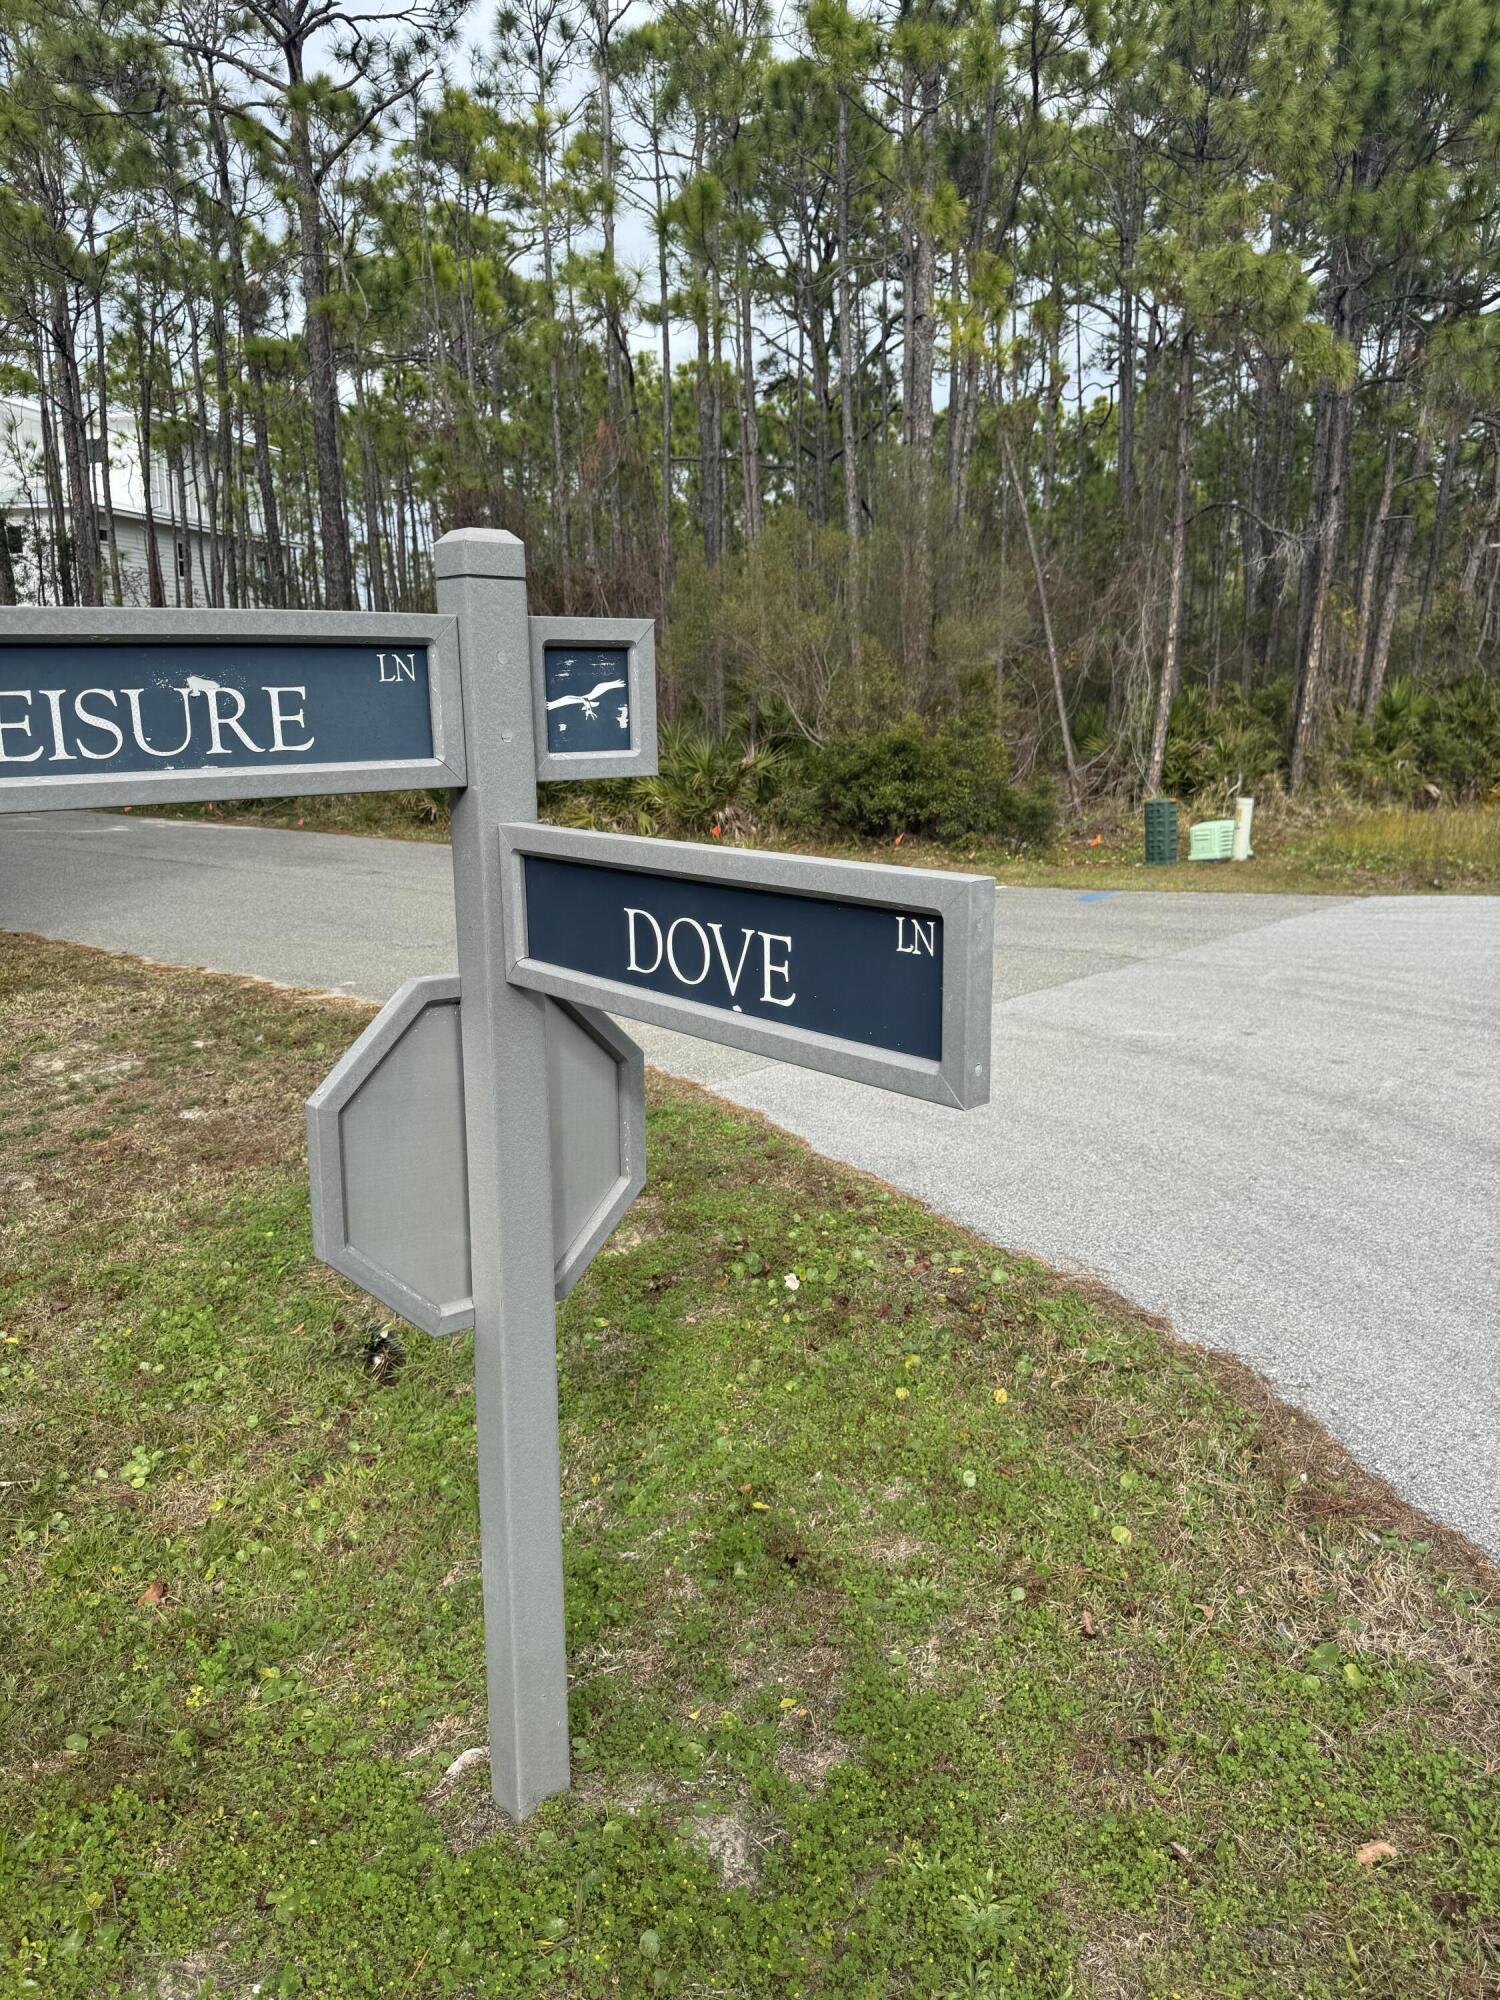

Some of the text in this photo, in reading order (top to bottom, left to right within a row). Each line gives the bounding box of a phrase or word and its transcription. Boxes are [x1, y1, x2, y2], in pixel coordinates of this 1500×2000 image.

[0, 653, 417, 762] EISURE LN
[623, 907, 936, 1007] DOVE LN
